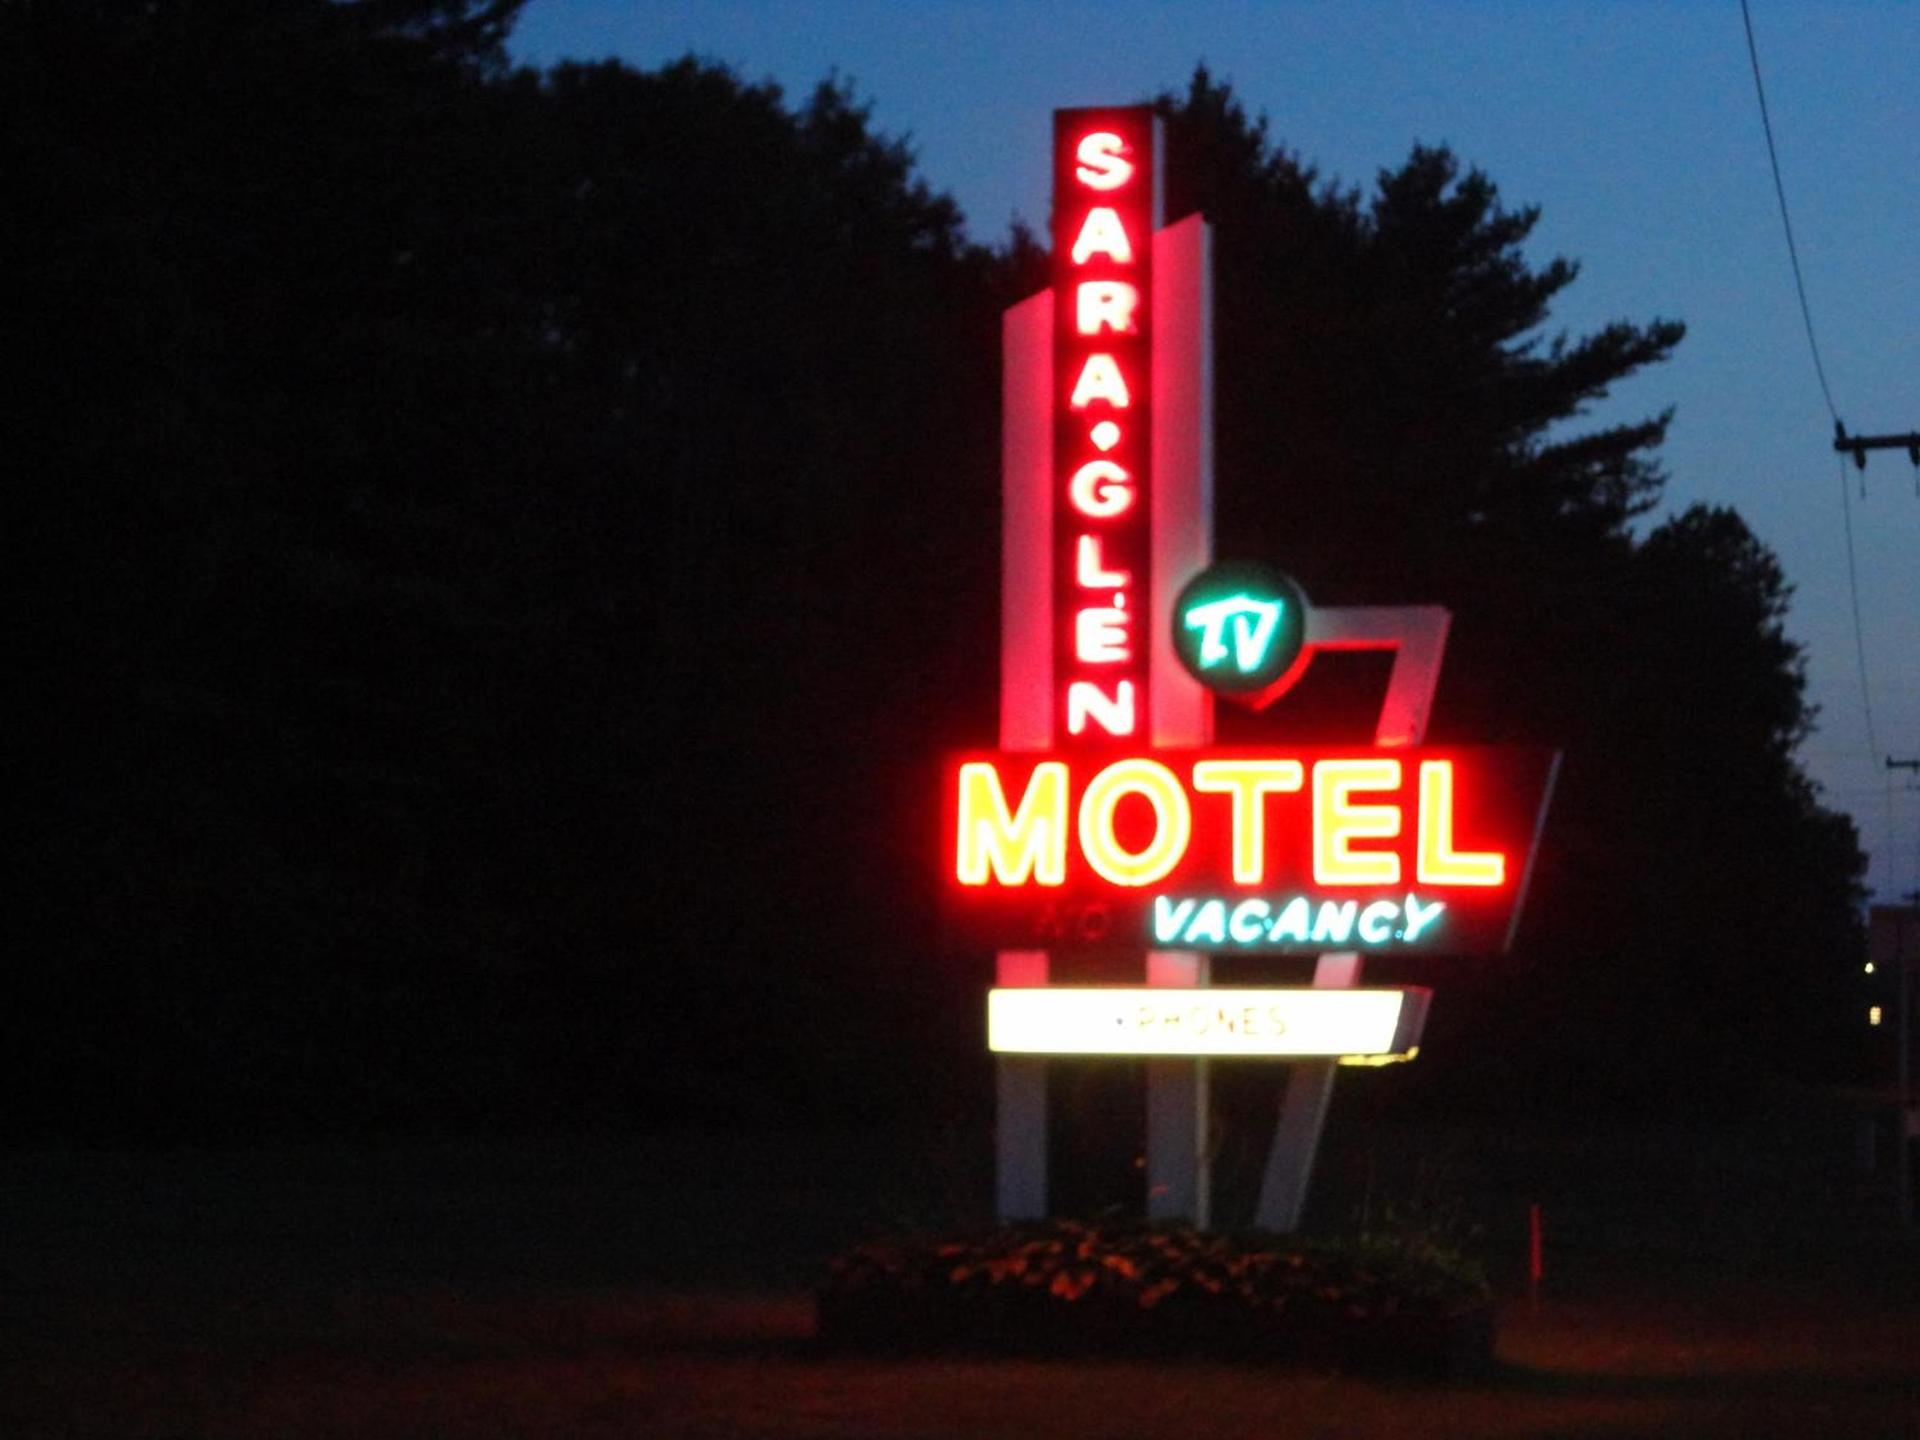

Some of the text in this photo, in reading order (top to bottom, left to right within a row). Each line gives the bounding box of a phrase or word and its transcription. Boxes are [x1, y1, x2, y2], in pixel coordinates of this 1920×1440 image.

[1184, 593, 1283, 674] TV
[956, 757, 1506, 887] MOTEL
[1154, 892, 1446, 943] VACANCY
